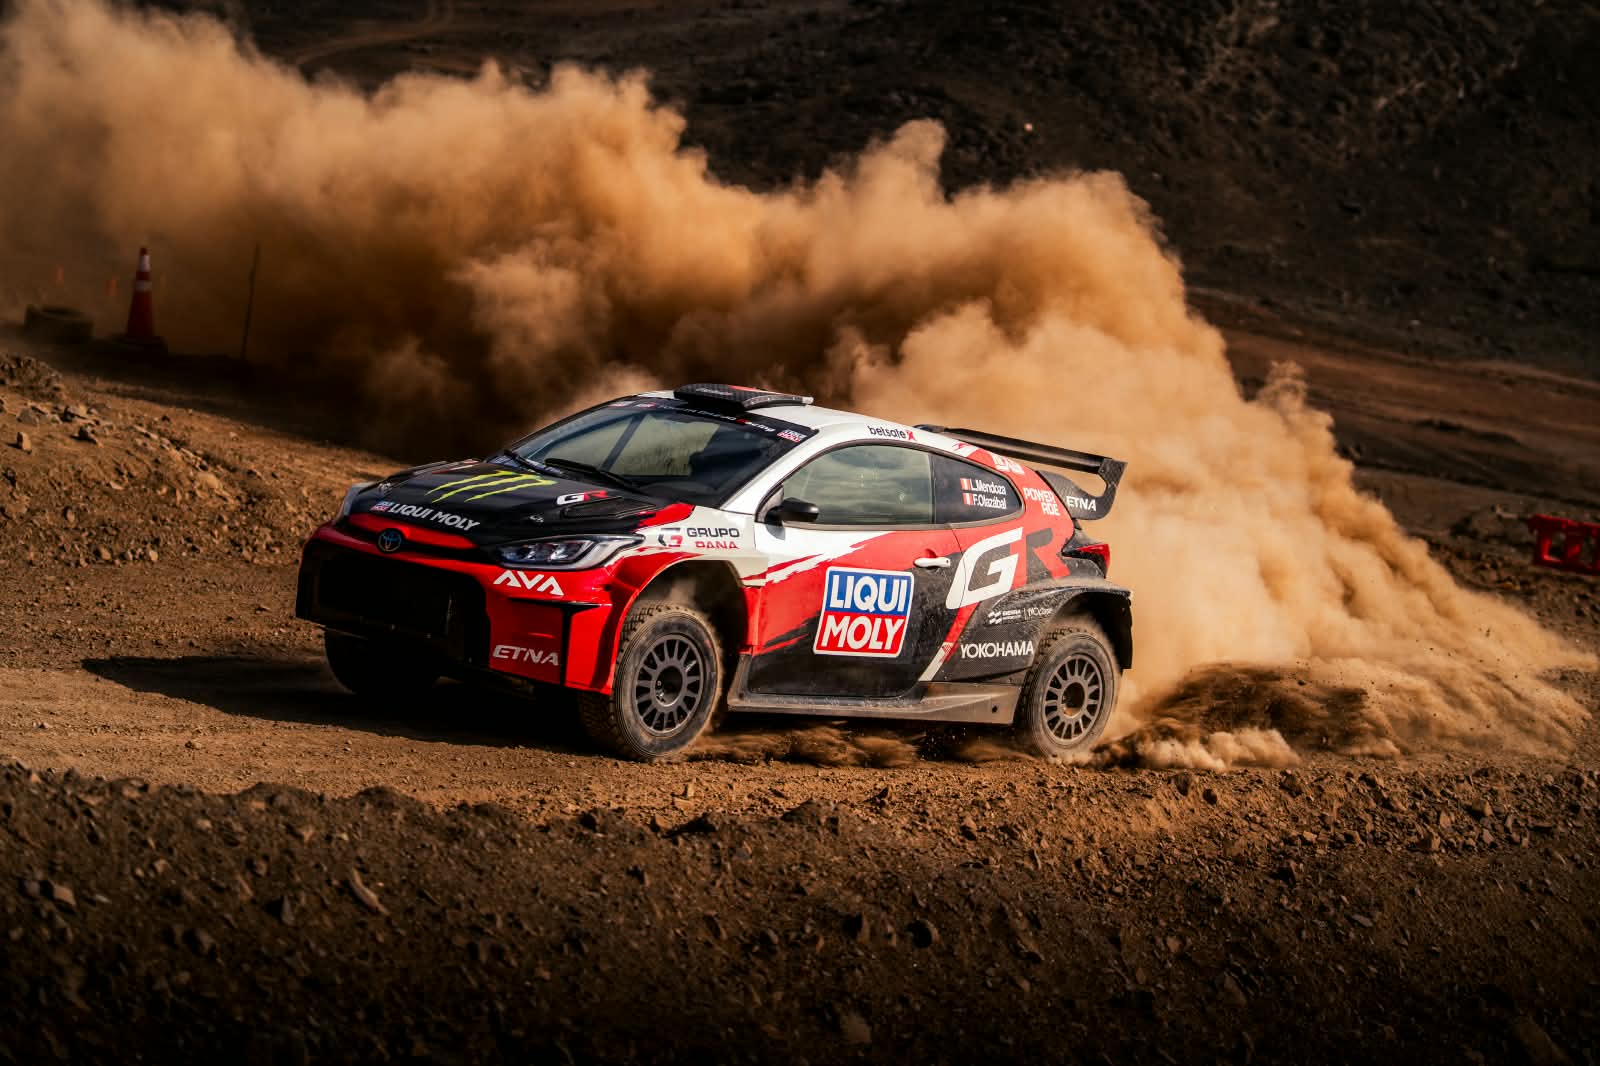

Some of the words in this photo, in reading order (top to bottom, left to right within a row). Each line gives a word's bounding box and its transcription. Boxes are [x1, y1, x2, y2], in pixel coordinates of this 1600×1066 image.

[1023, 487, 1056, 504] POWER
[1066, 495, 1097, 512] ETNA
[388, 503, 434, 519] LIQUI
[430, 511, 480, 531] MOLY
[686, 528, 740, 538] GRUPO
[493, 570, 564, 596] AVA
[829, 574, 908, 613] LIQUI
[821, 614, 905, 650] MOLY
[492, 644, 560, 666] ETNA
[960, 640, 1035, 659] YOKOHAMA
